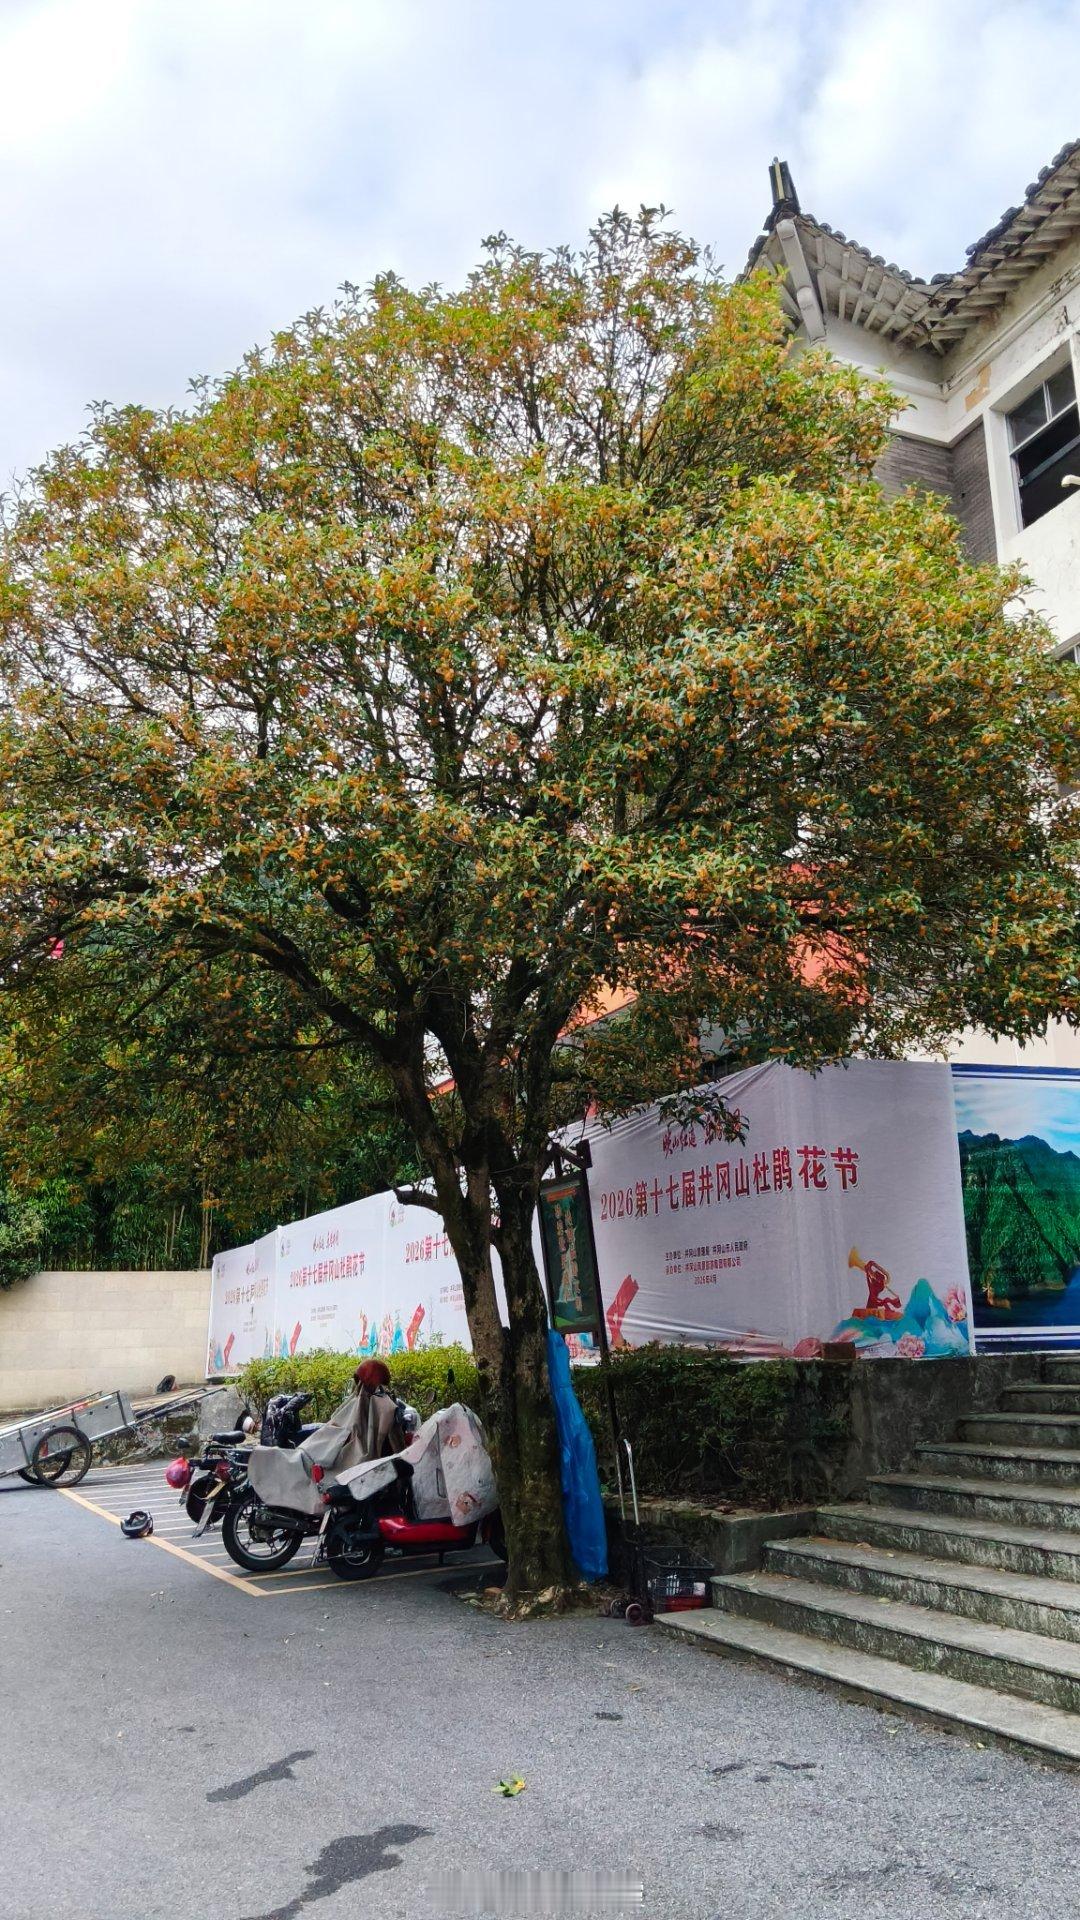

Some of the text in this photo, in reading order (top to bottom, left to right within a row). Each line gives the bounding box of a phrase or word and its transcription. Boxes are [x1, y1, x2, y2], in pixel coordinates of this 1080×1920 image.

[600, 1145, 862, 1221] 2026第十七届井冈山杜鹃花节
[404, 1232, 456, 1263] 2026第十七
